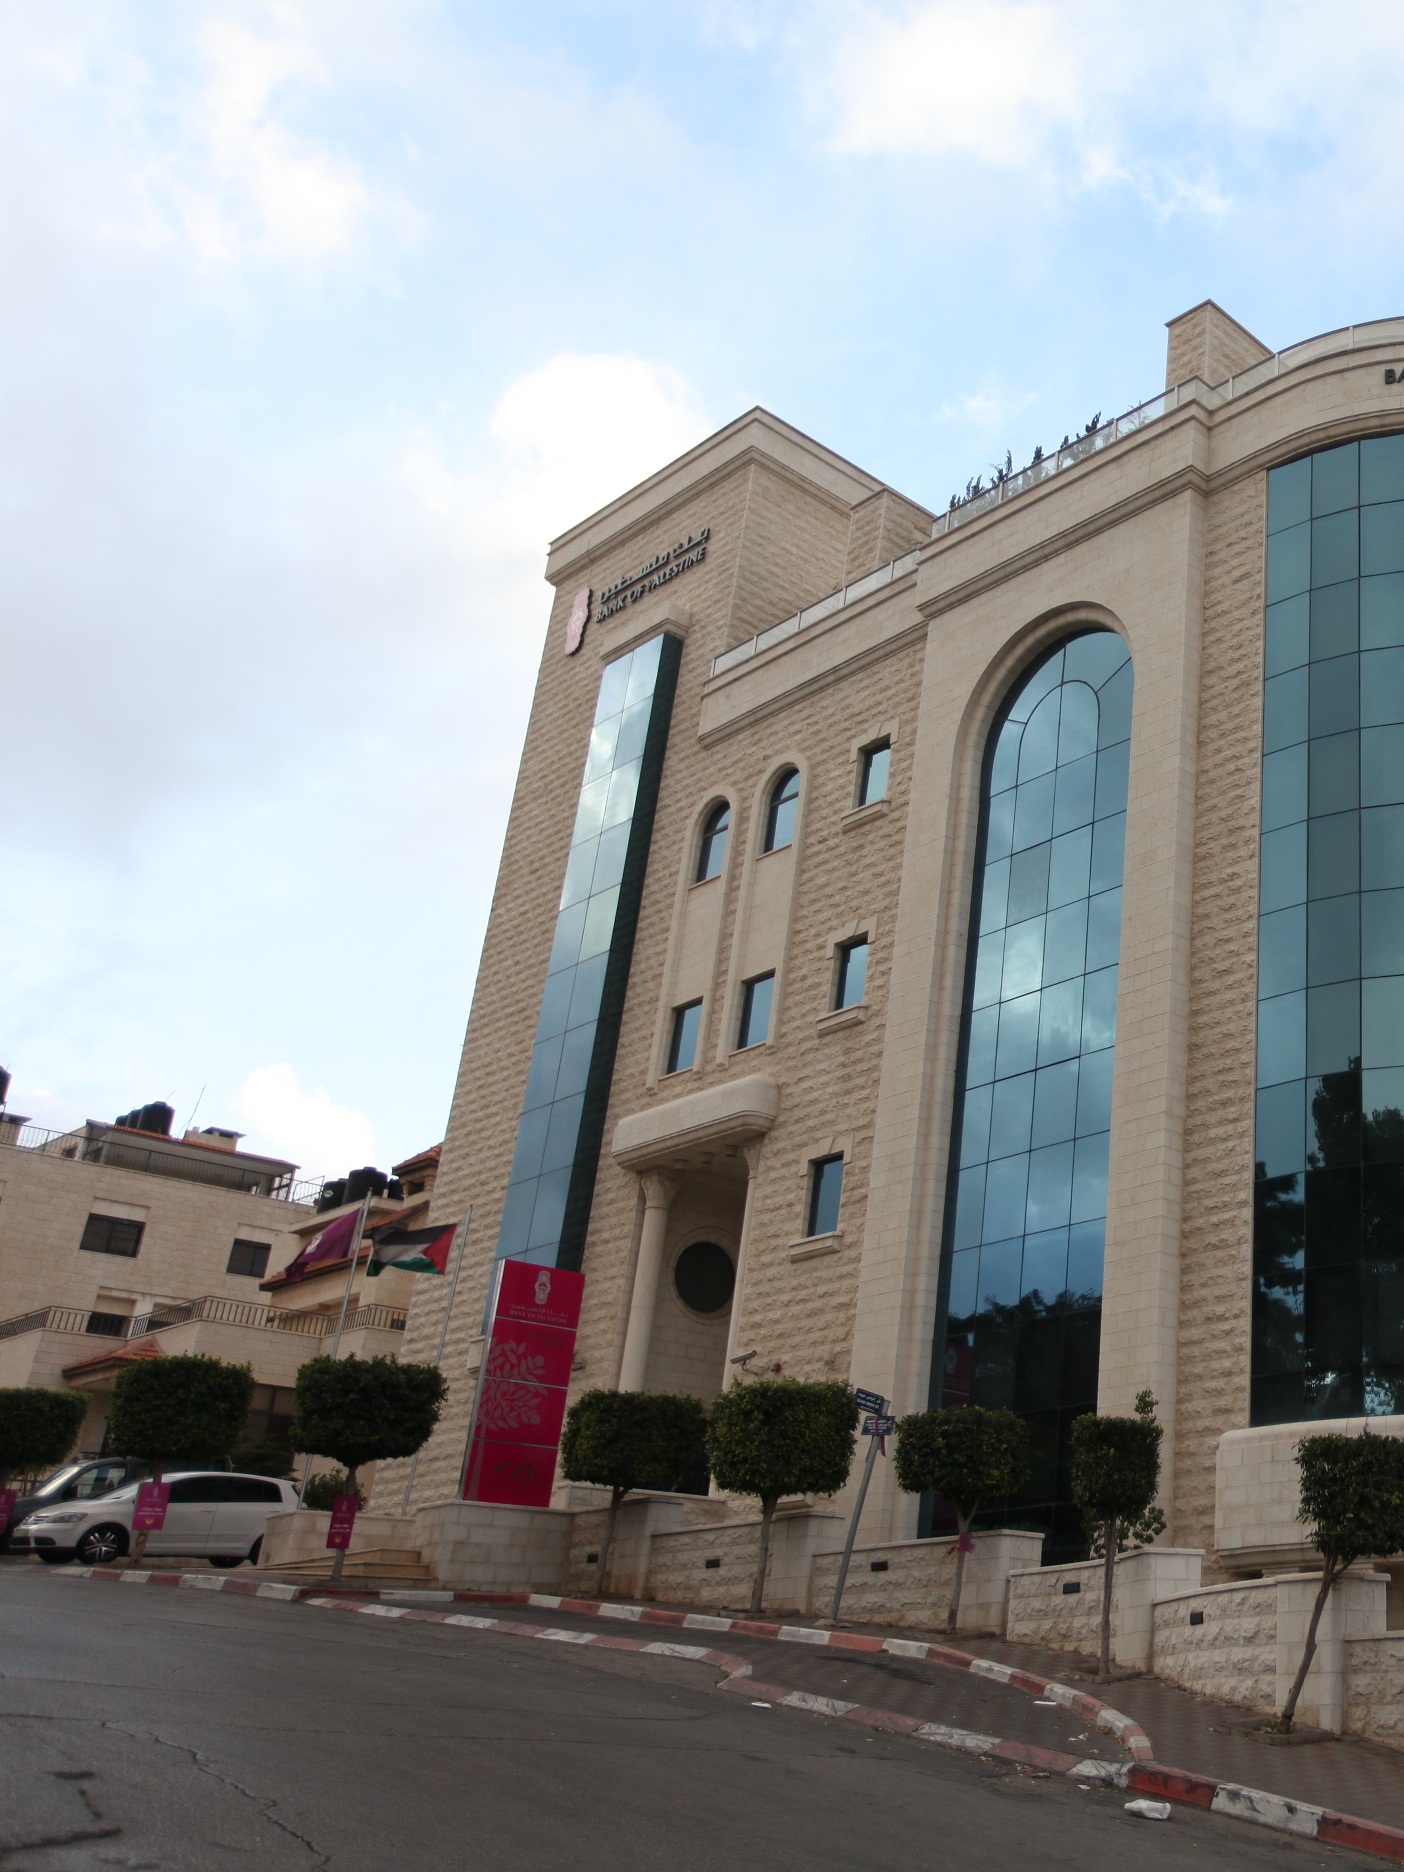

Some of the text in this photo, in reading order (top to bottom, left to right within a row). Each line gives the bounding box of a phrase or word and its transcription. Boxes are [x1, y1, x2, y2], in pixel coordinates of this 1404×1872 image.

[596, 546, 708, 624] BANK OF PALESTINE
[600, 551, 671, 605] فلسطين
[537, 1314, 568, 1324] PALESTINE
